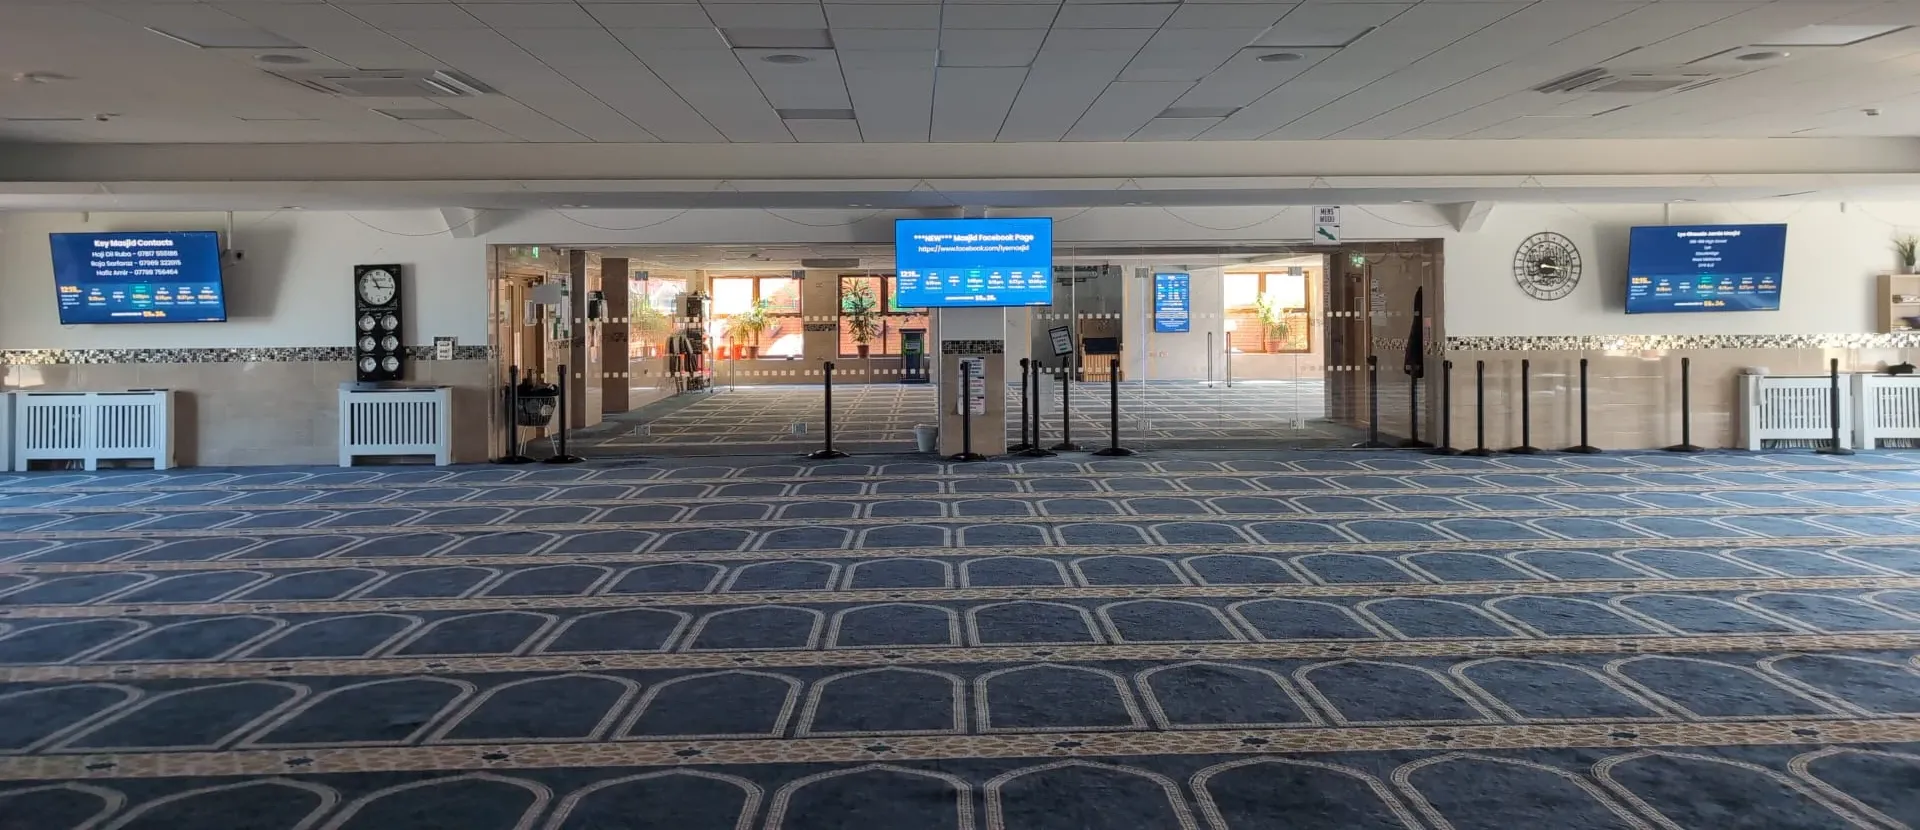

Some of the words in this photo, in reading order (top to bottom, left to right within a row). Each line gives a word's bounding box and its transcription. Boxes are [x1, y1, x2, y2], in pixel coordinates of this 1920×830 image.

[953, 234, 978, 243] Masjid
[1015, 234, 1034, 243] Page
[94, 240, 109, 248] Key
[110, 239, 136, 248] Masjid
